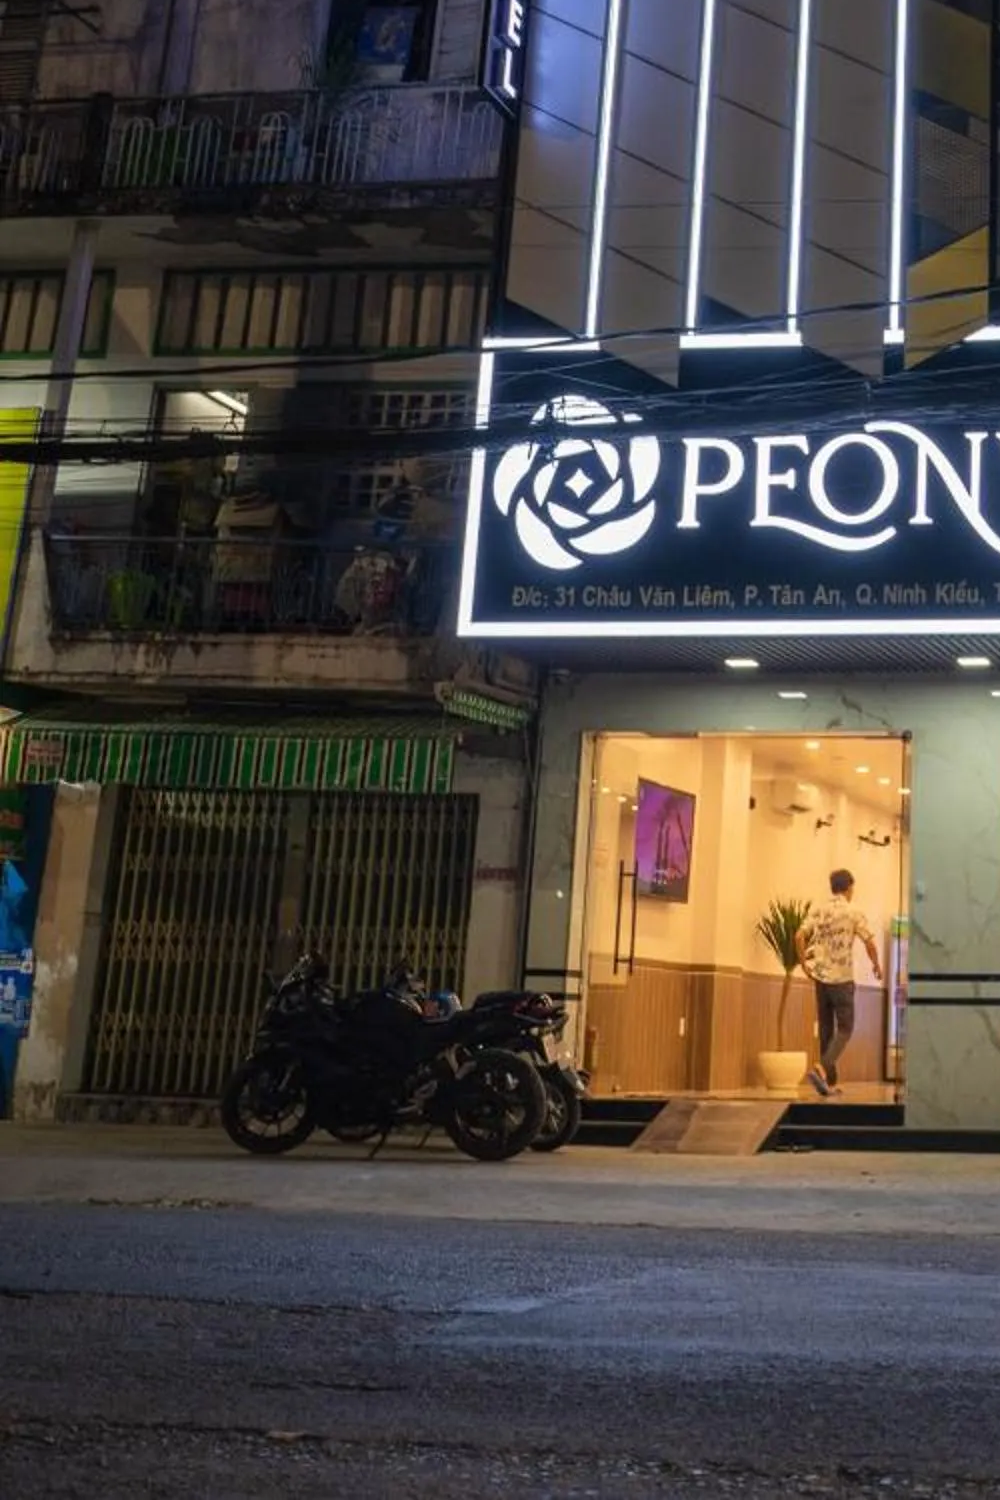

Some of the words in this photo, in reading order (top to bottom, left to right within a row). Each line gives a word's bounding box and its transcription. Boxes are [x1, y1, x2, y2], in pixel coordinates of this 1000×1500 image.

[554, 585, 575, 607] 31
[582, 584, 631, 607] Châu
[682, 583, 735, 609] Liêm,
[744, 583, 764, 607] P.
[769, 582, 805, 606] Tân
[812, 582, 846, 609] An,
[855, 583, 878, 606] Q.
[883, 583, 927, 606] Ninh
